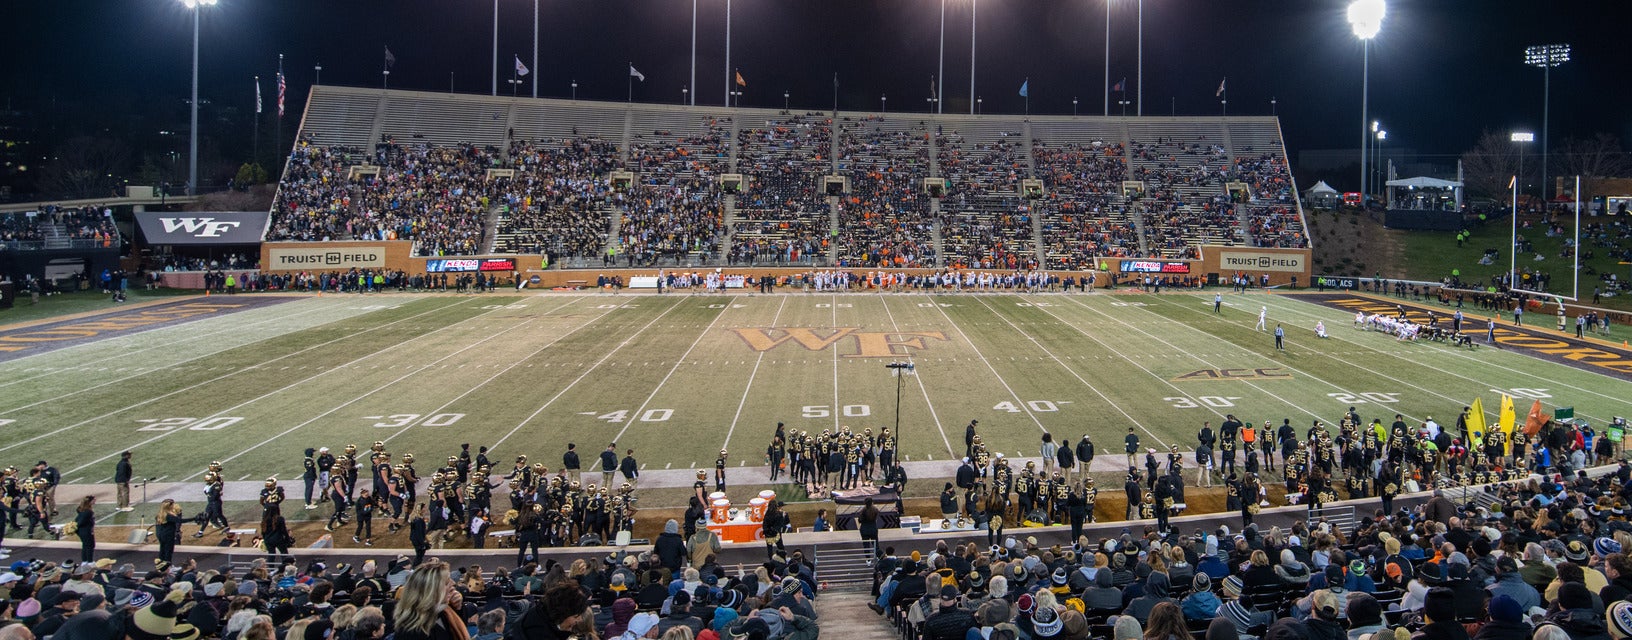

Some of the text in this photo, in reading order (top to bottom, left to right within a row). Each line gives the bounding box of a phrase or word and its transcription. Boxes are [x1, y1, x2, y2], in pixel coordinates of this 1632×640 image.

[159, 217, 241, 238] WF
[279, 253, 378, 264] TRUIST FIELD
[1226, 257, 1298, 267] TRUIST FIELD
[726, 326, 952, 359] WF
[1170, 367, 1292, 382] ACC
[1162, 396, 1236, 409] 30
[1326, 391, 1401, 404] 20
[801, 404, 871, 418] 50
[992, 399, 1060, 413] 40
[372, 413, 467, 428] 30
[597, 408, 675, 423] 40
[136, 416, 245, 431] 20
[1488, 437, 1499, 447] 57
[847, 453, 858, 463] 82
[1057, 489, 1068, 500] 25
